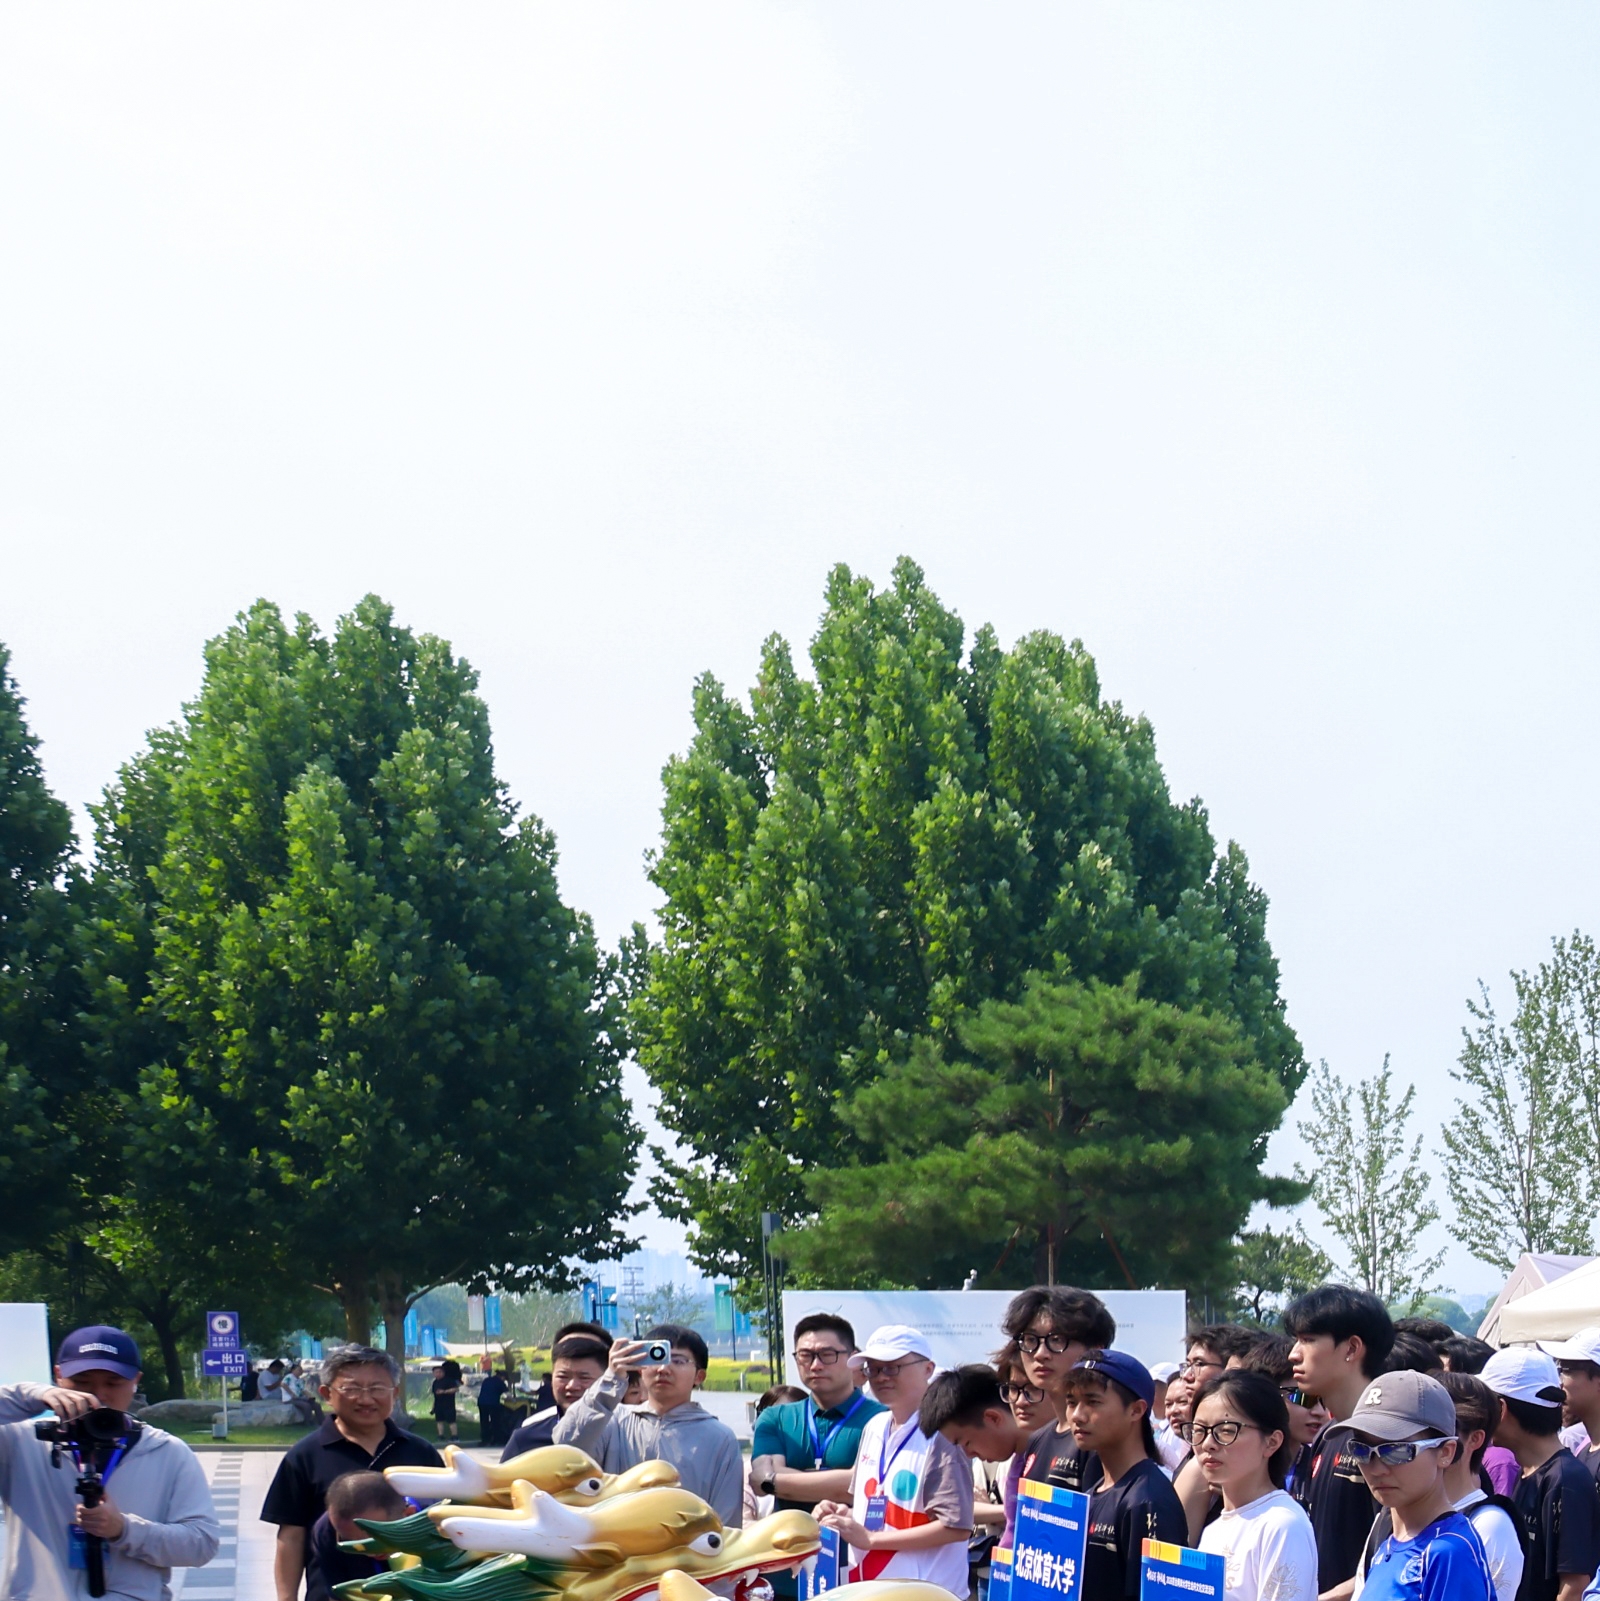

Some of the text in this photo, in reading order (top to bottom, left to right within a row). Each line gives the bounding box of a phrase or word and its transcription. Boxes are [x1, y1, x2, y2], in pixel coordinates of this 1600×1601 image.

[222, 1353, 245, 1364] 出口
[1365, 1387, 1381, 1405] R
[1015, 1542, 1076, 1595] 北京体育大学
